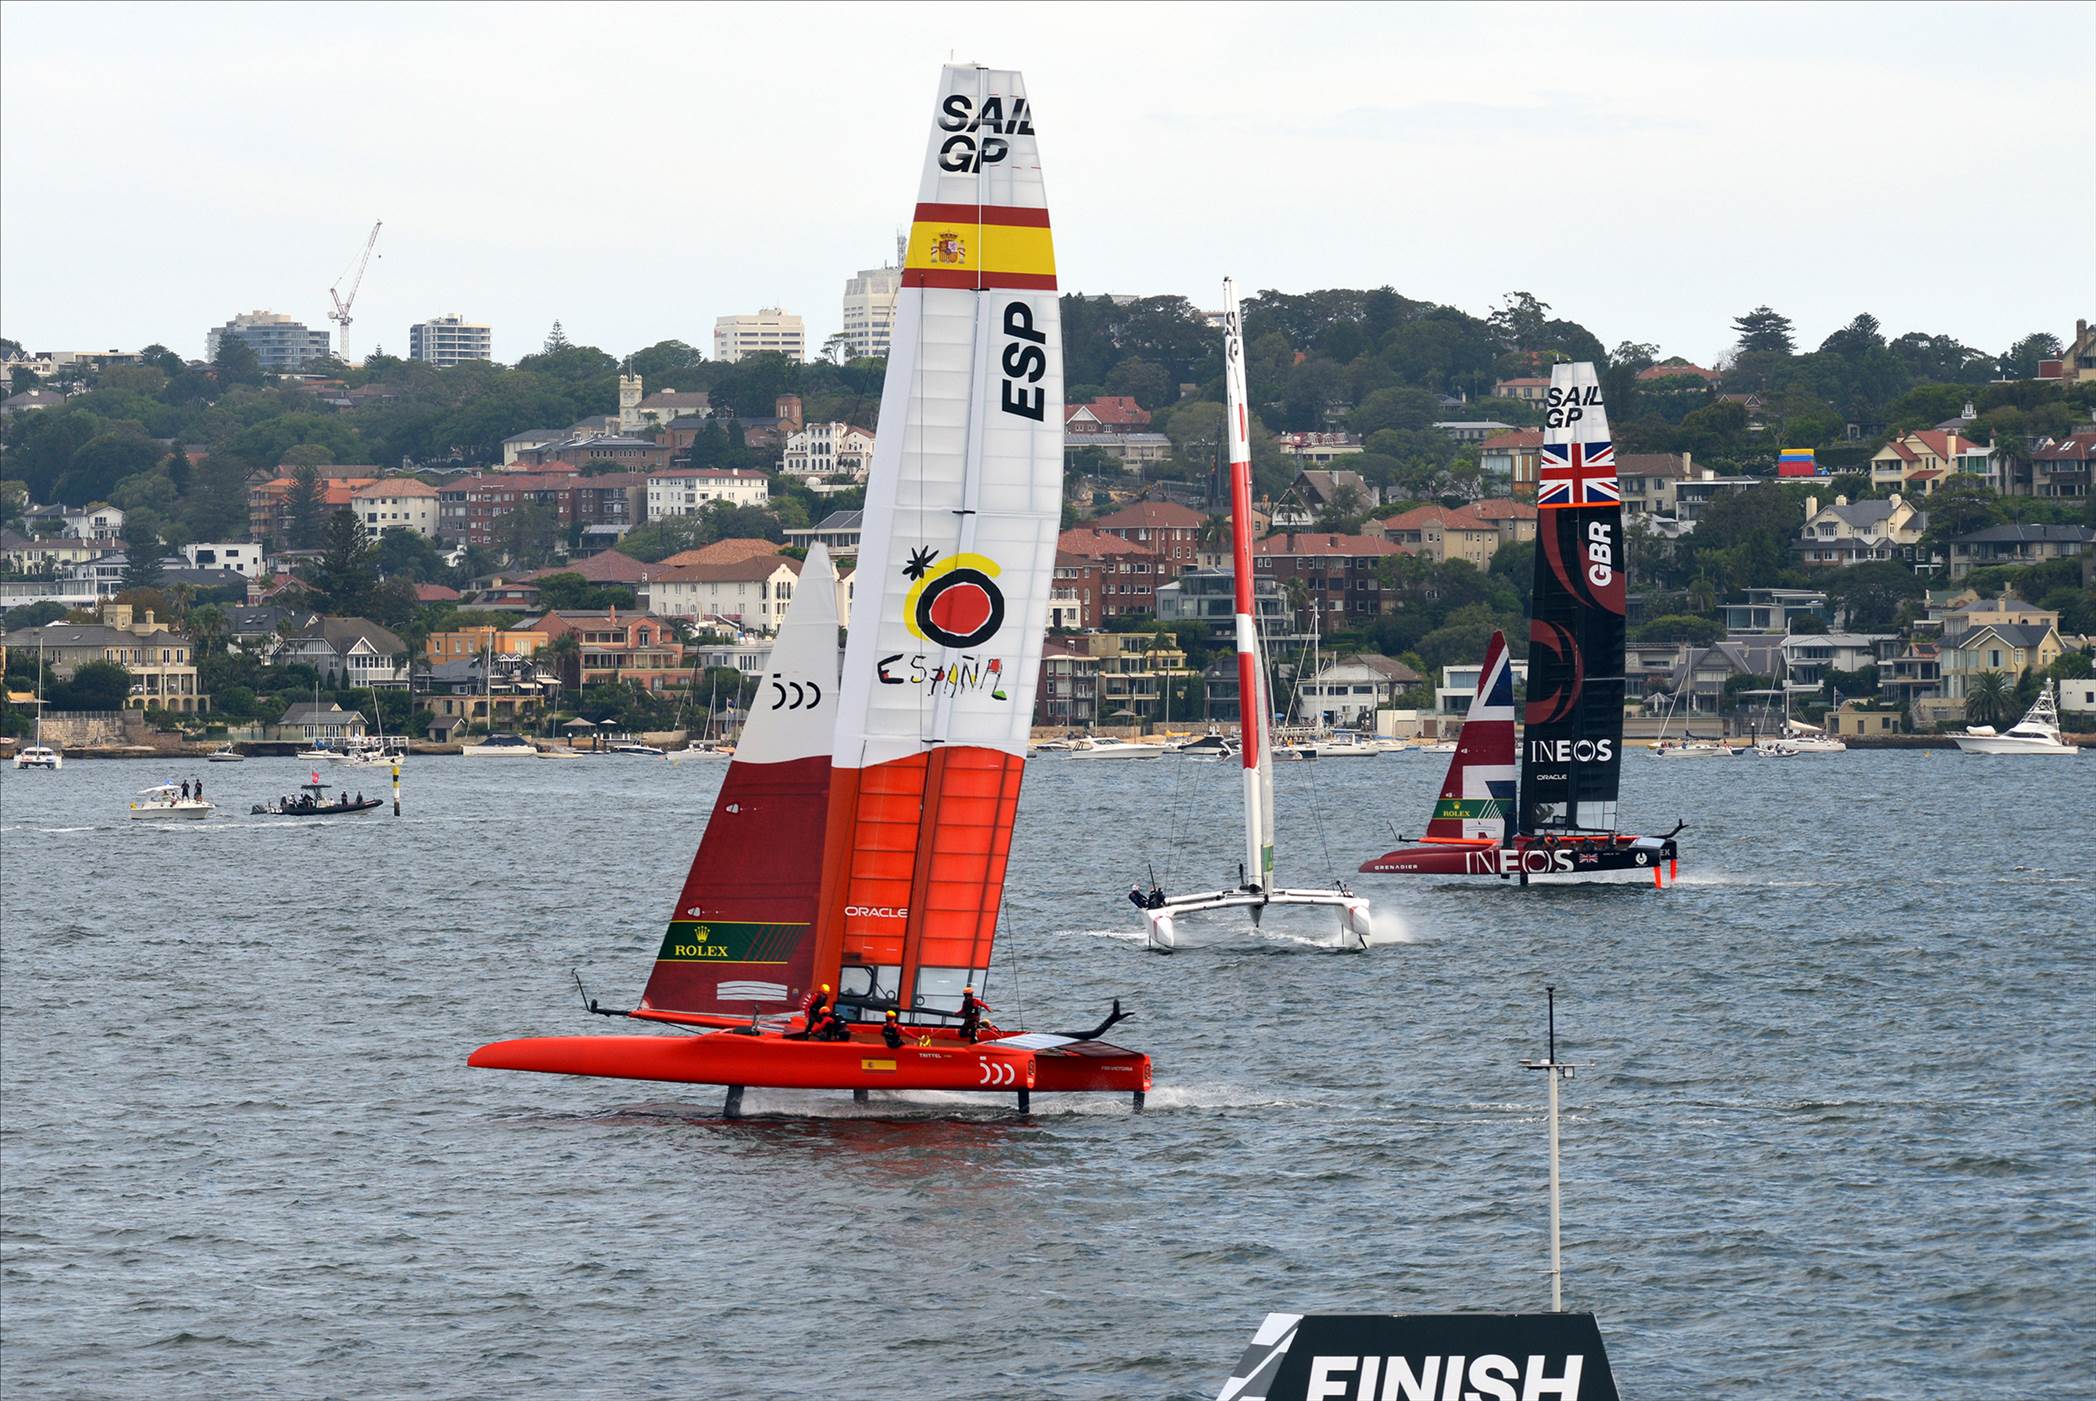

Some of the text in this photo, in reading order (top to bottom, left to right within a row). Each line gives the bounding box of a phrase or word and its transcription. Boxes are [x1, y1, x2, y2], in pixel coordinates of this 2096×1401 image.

[937, 94, 1035, 135] SAIL
[937, 135, 1009, 174] GP
[1002, 301, 1046, 422] ESP
[1547, 386, 1604, 408] SAIL
[1545, 407, 1583, 429] GP
[1588, 521, 1612, 587] GBR
[877, 653, 1007, 700] ESPAÑA
[1531, 739, 1612, 762] INEOS
[1465, 849, 1574, 874] INEOS
[844, 906, 908, 918] ORACLE
[675, 945, 728, 957] ROLEX
[1306, 1353, 1584, 1401] FINISH
